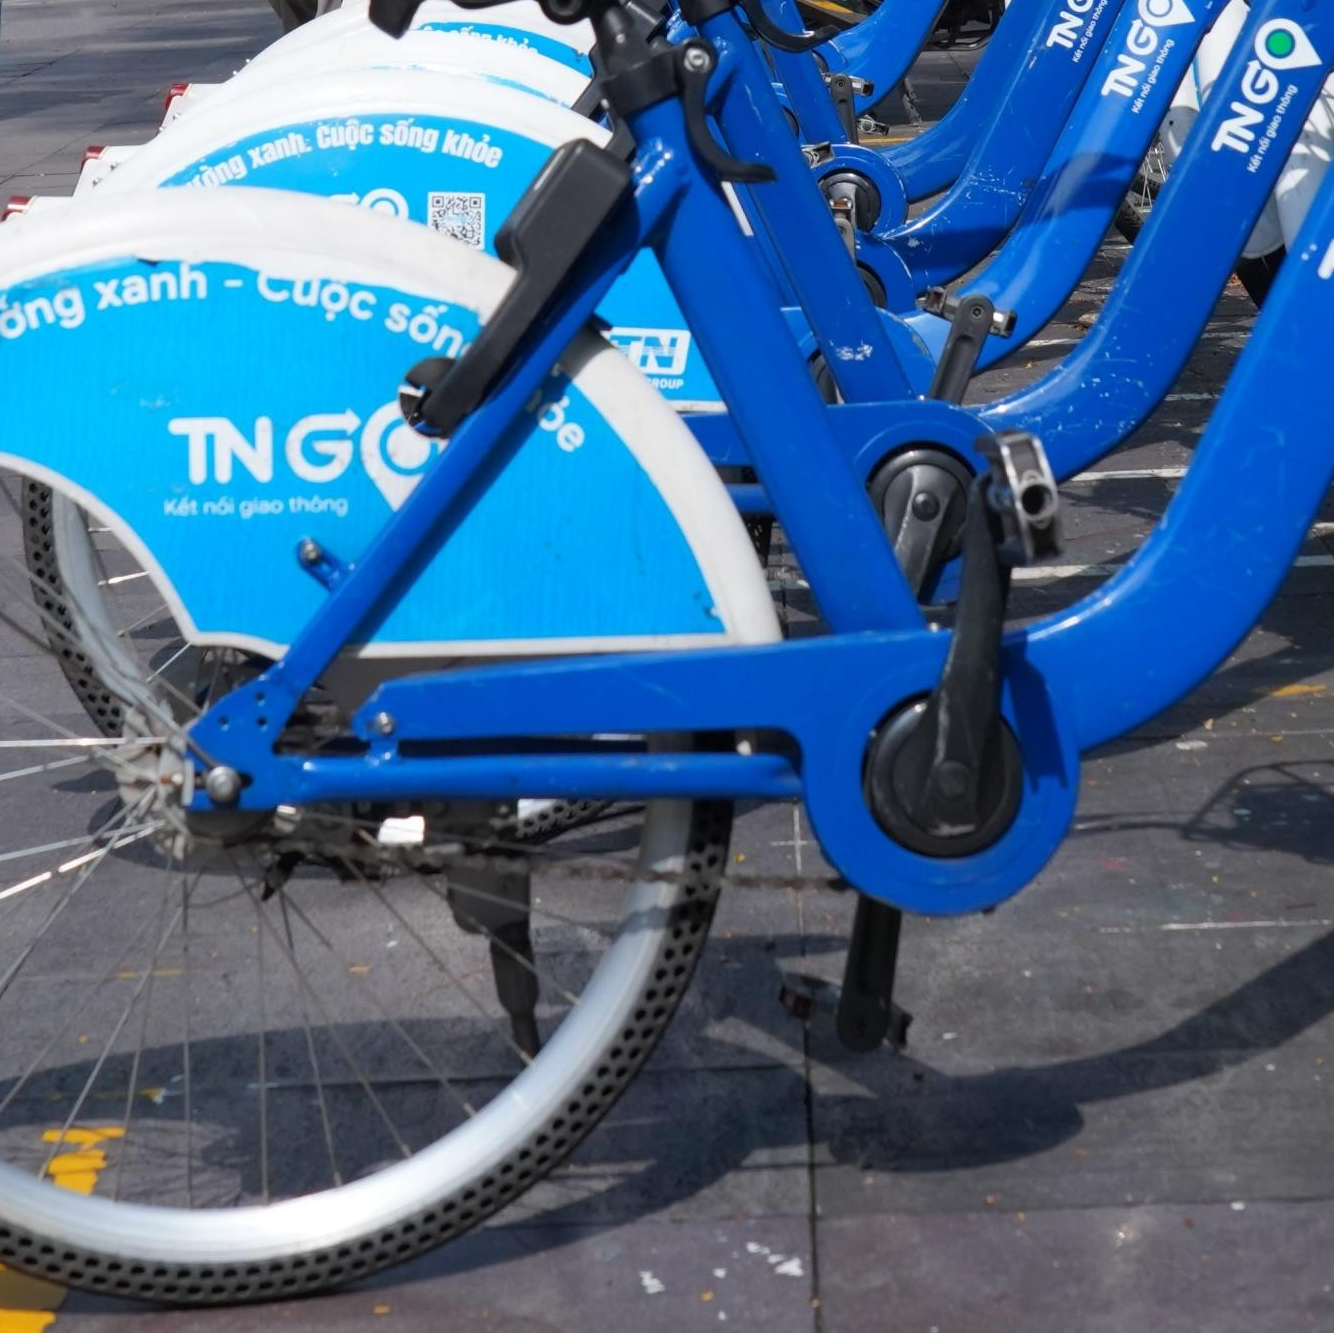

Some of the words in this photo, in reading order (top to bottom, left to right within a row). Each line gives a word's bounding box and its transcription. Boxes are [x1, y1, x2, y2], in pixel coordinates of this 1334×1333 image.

[1265, 109, 1282, 139] giao
[1277, 84, 1299, 115] thông
[316, 119, 373, 148] Cuộc
[380, 115, 437, 153] sống
[444, 128, 503, 169] khỏe
[94, 262, 208, 311] xanh
[384, 302, 473, 359] sốn
[609, 334, 678, 370] TN
[168, 415, 273, 485] TN
[163, 497, 198, 517] Kết
[204, 496, 235, 516] nối
[240, 498, 284, 519] giao
[290, 495, 348, 516] thông
